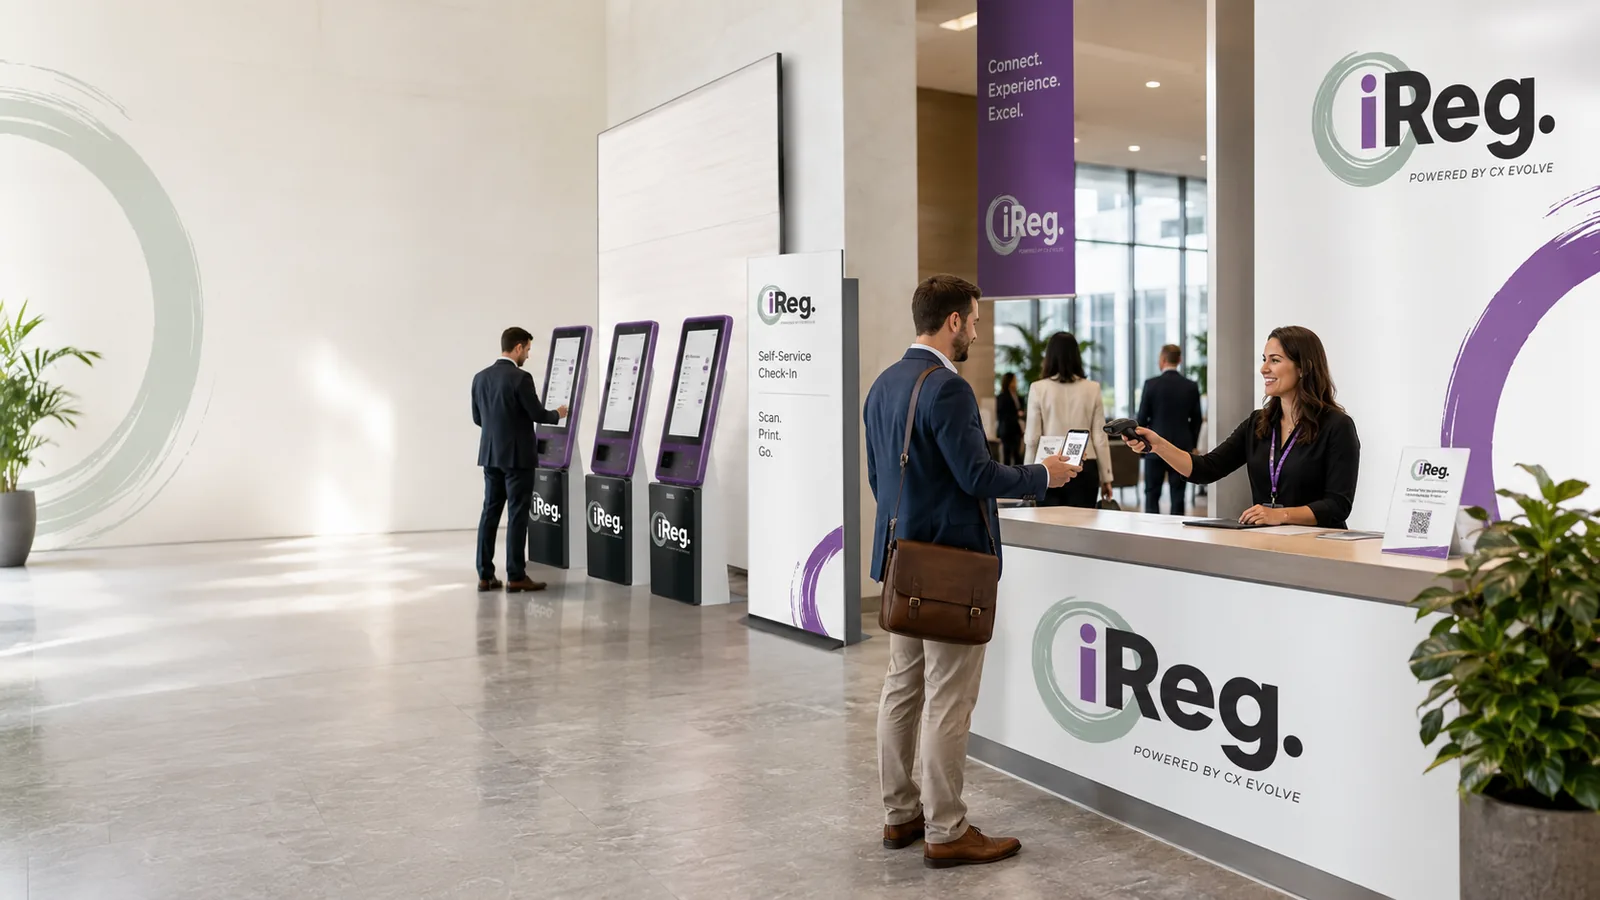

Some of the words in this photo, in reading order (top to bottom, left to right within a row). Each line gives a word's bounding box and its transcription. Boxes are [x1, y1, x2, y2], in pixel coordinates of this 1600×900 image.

[988, 52, 1042, 74] Connect.
[988, 75, 1061, 99] Experience.
[988, 103, 1024, 121] Excel.
[1361, 70, 1555, 160] iReg.
[1409, 169, 1467, 183] POWERED
[1471, 168, 1486, 178] BY
[1489, 166, 1505, 176] CX
[1508, 162, 1554, 176] EVOLVE
[1003, 205, 1064, 246] iReg.
[768, 291, 816, 319] iReg.
[758, 350, 812, 362] Self-Service
[758, 367, 798, 379] Check-In
[758, 411, 782, 423] Scan.
[758, 428, 782, 441] Print.
[758, 446, 773, 458] Go.
[1419, 463, 1449, 479] iReg.
[533, 496, 561, 522] iReg.
[593, 506, 623, 534] iReg.
[658, 518, 691, 549] iReg.
[1080, 623, 1303, 772] iReg.
[1133, 745, 1199, 773] POWERED
[1202, 765, 1220, 780] BY
[1224, 772, 1242, 786] CX
[1246, 777, 1301, 804] EVOLVE
